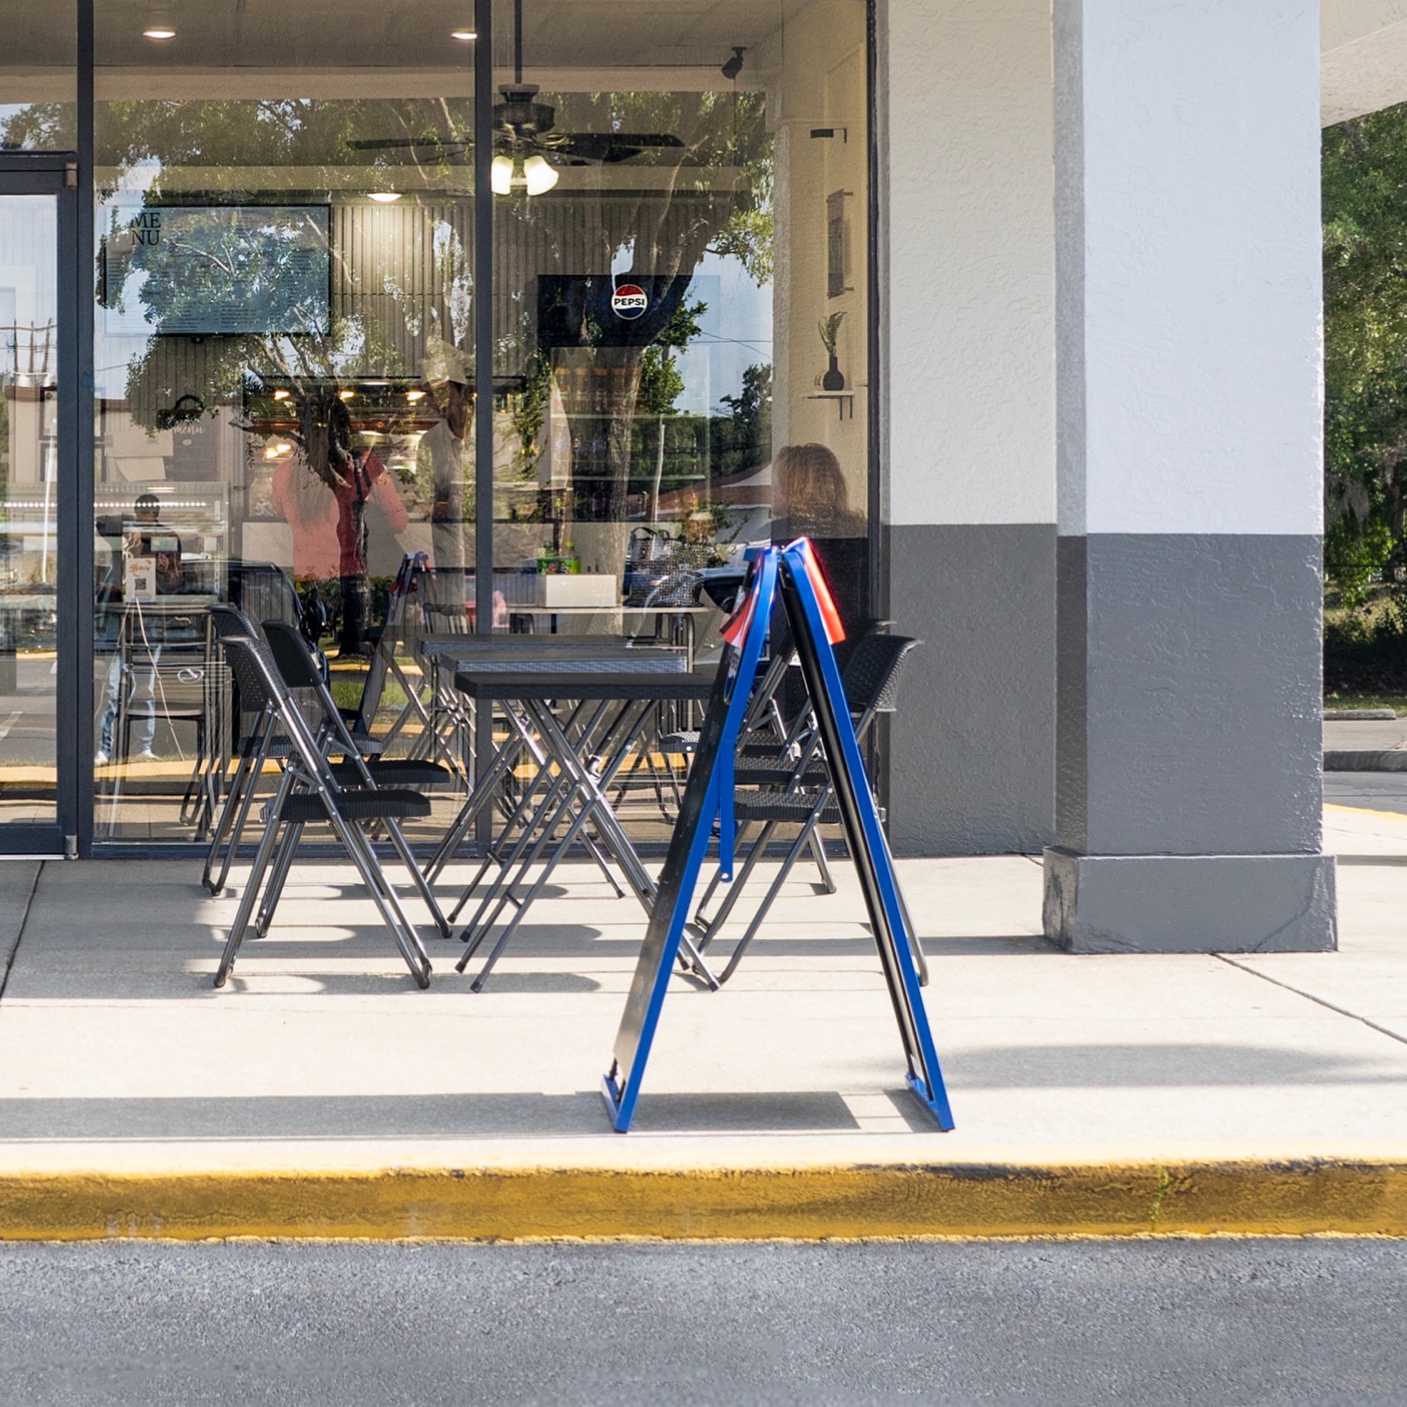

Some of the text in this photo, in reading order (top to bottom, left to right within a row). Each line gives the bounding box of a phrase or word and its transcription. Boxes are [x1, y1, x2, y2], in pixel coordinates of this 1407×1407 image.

[129, 212, 161, 228] ME
[130, 230, 160, 245] NU
[614, 297, 645, 306] PEPSI
